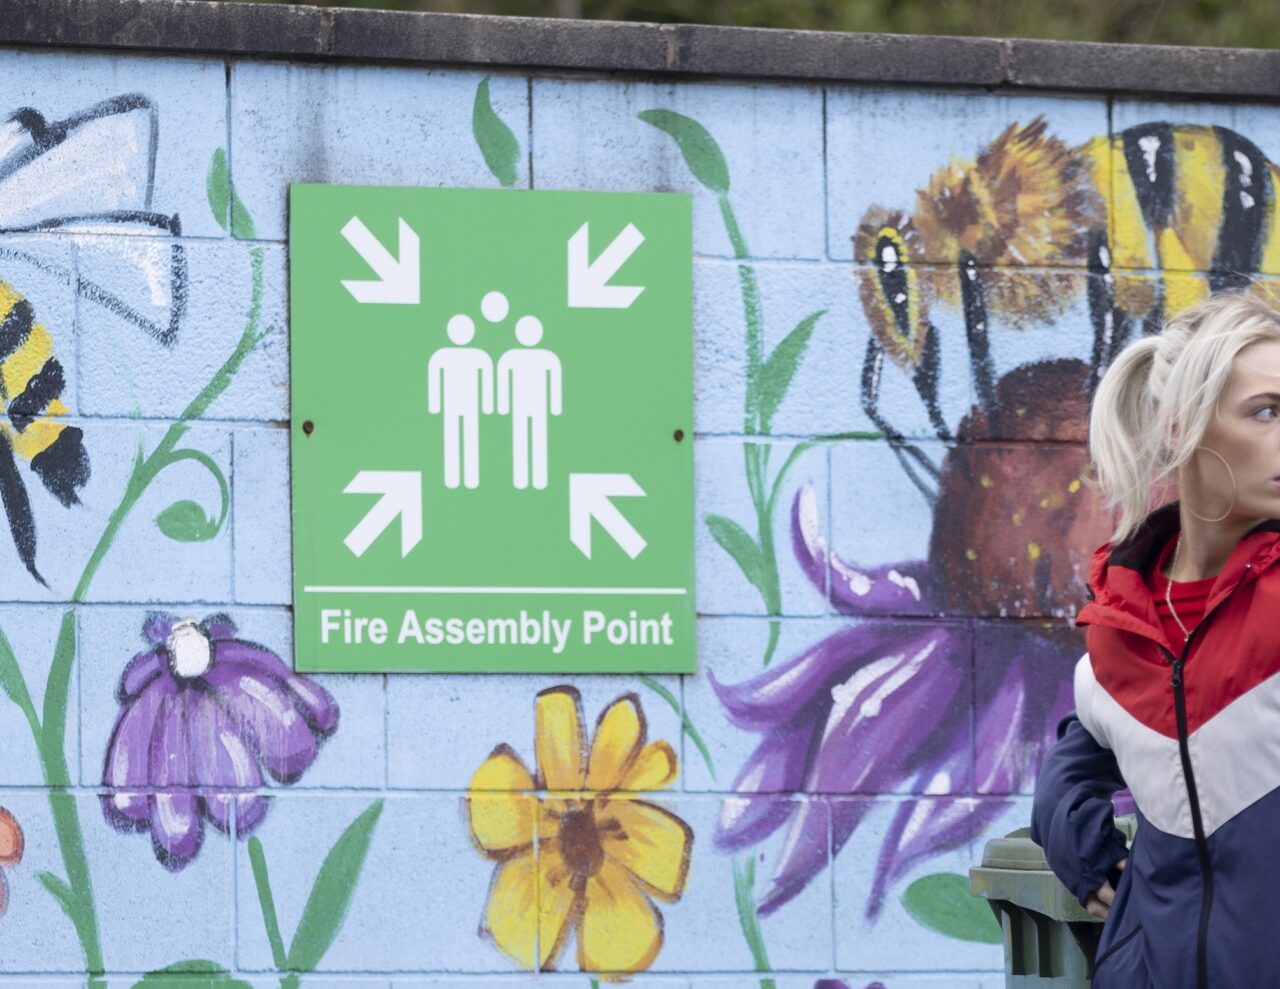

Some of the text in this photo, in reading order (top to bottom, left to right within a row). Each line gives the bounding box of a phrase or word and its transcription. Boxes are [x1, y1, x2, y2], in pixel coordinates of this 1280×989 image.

[320, 609, 674, 654] Fire Assembly Point
